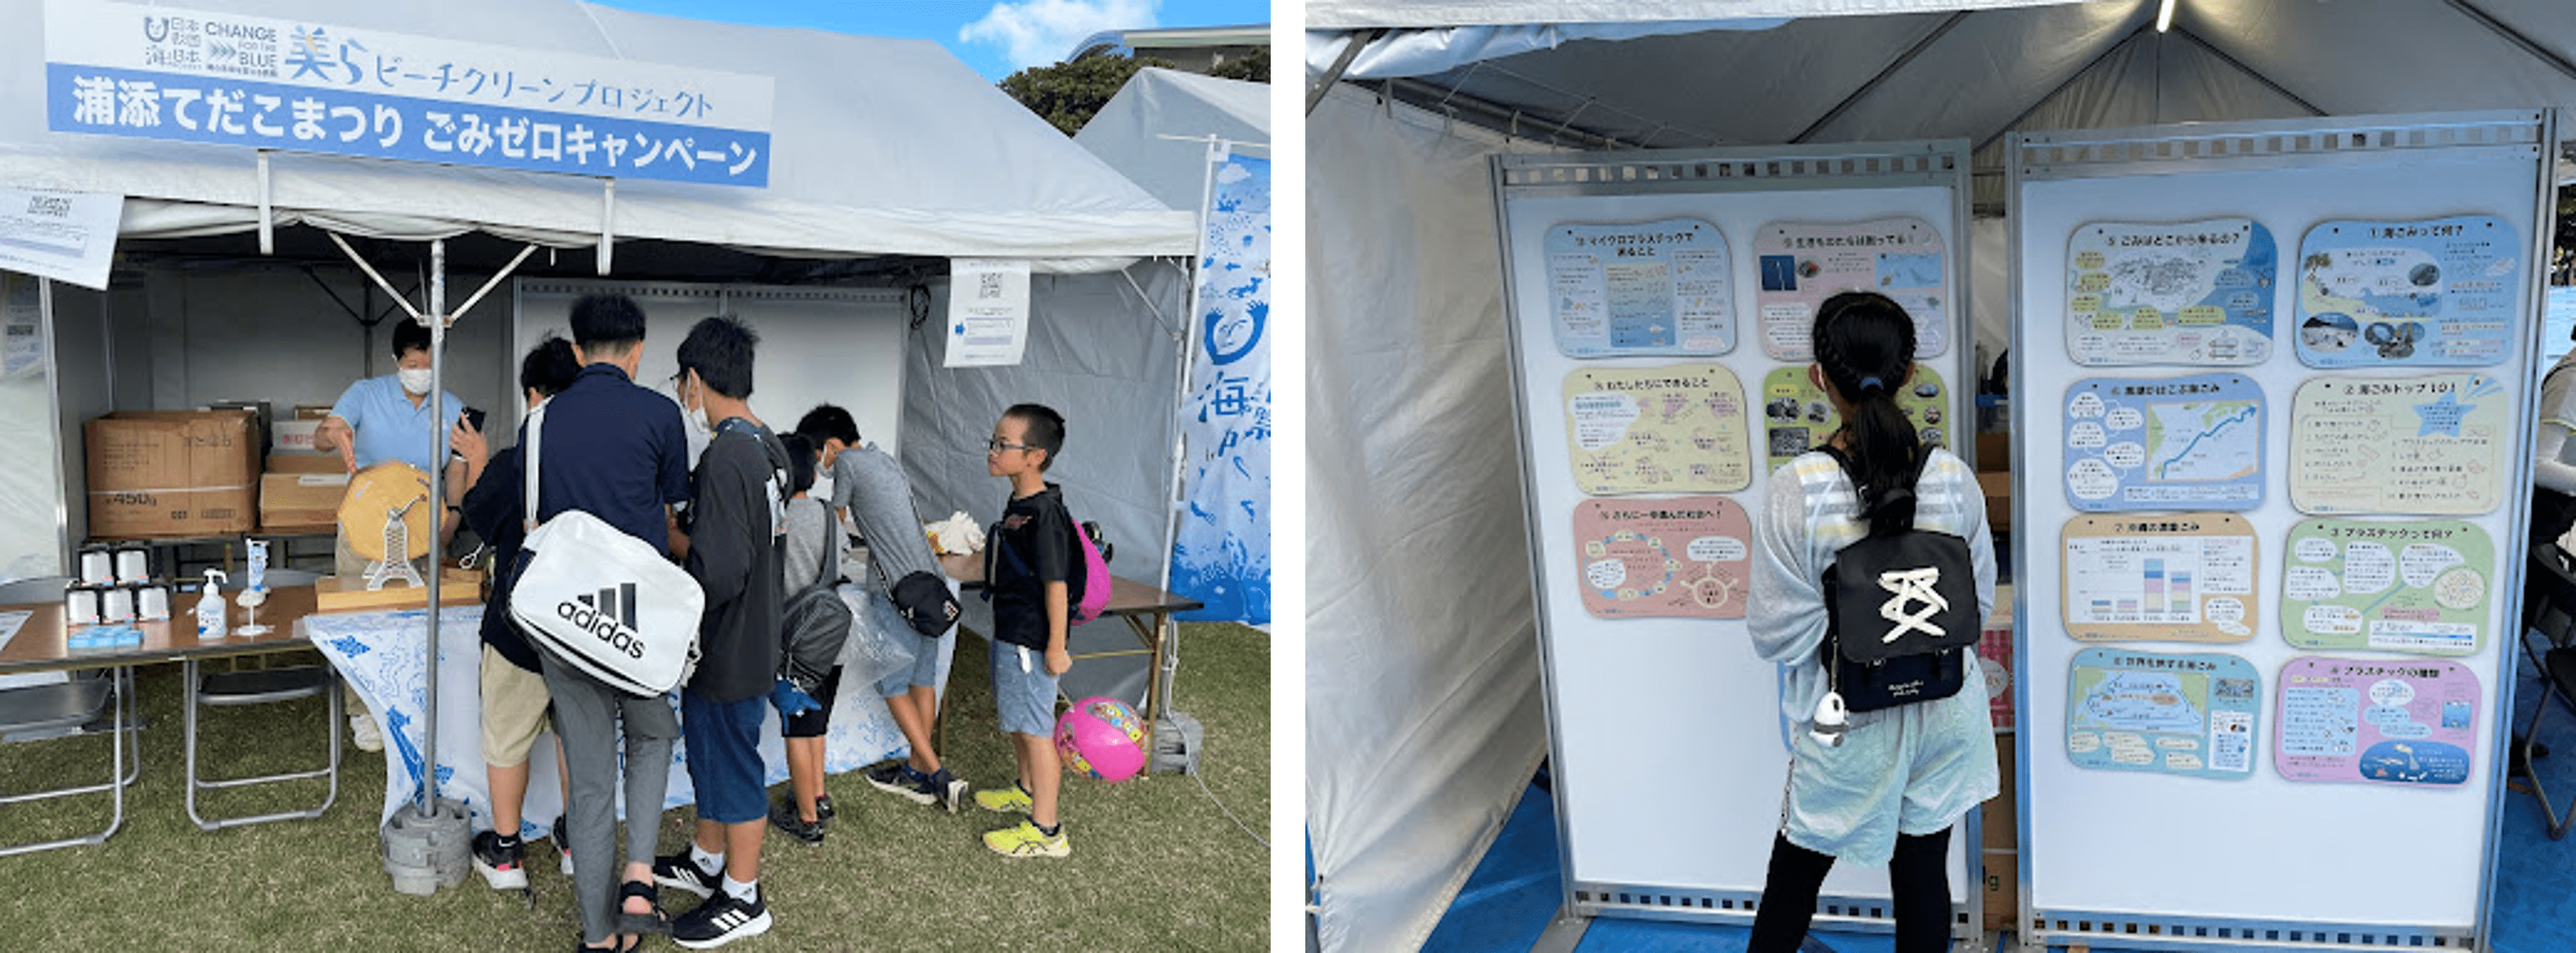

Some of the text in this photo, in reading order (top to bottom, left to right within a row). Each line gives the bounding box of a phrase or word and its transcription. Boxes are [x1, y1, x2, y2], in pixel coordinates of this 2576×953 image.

[205, 21, 277, 43] CHANGE
[239, 51, 277, 67] BLUE
[73, 74, 758, 176] 浦添てだこまつり ごみゼロキャンペーン
[557, 601, 646, 659] adidas
